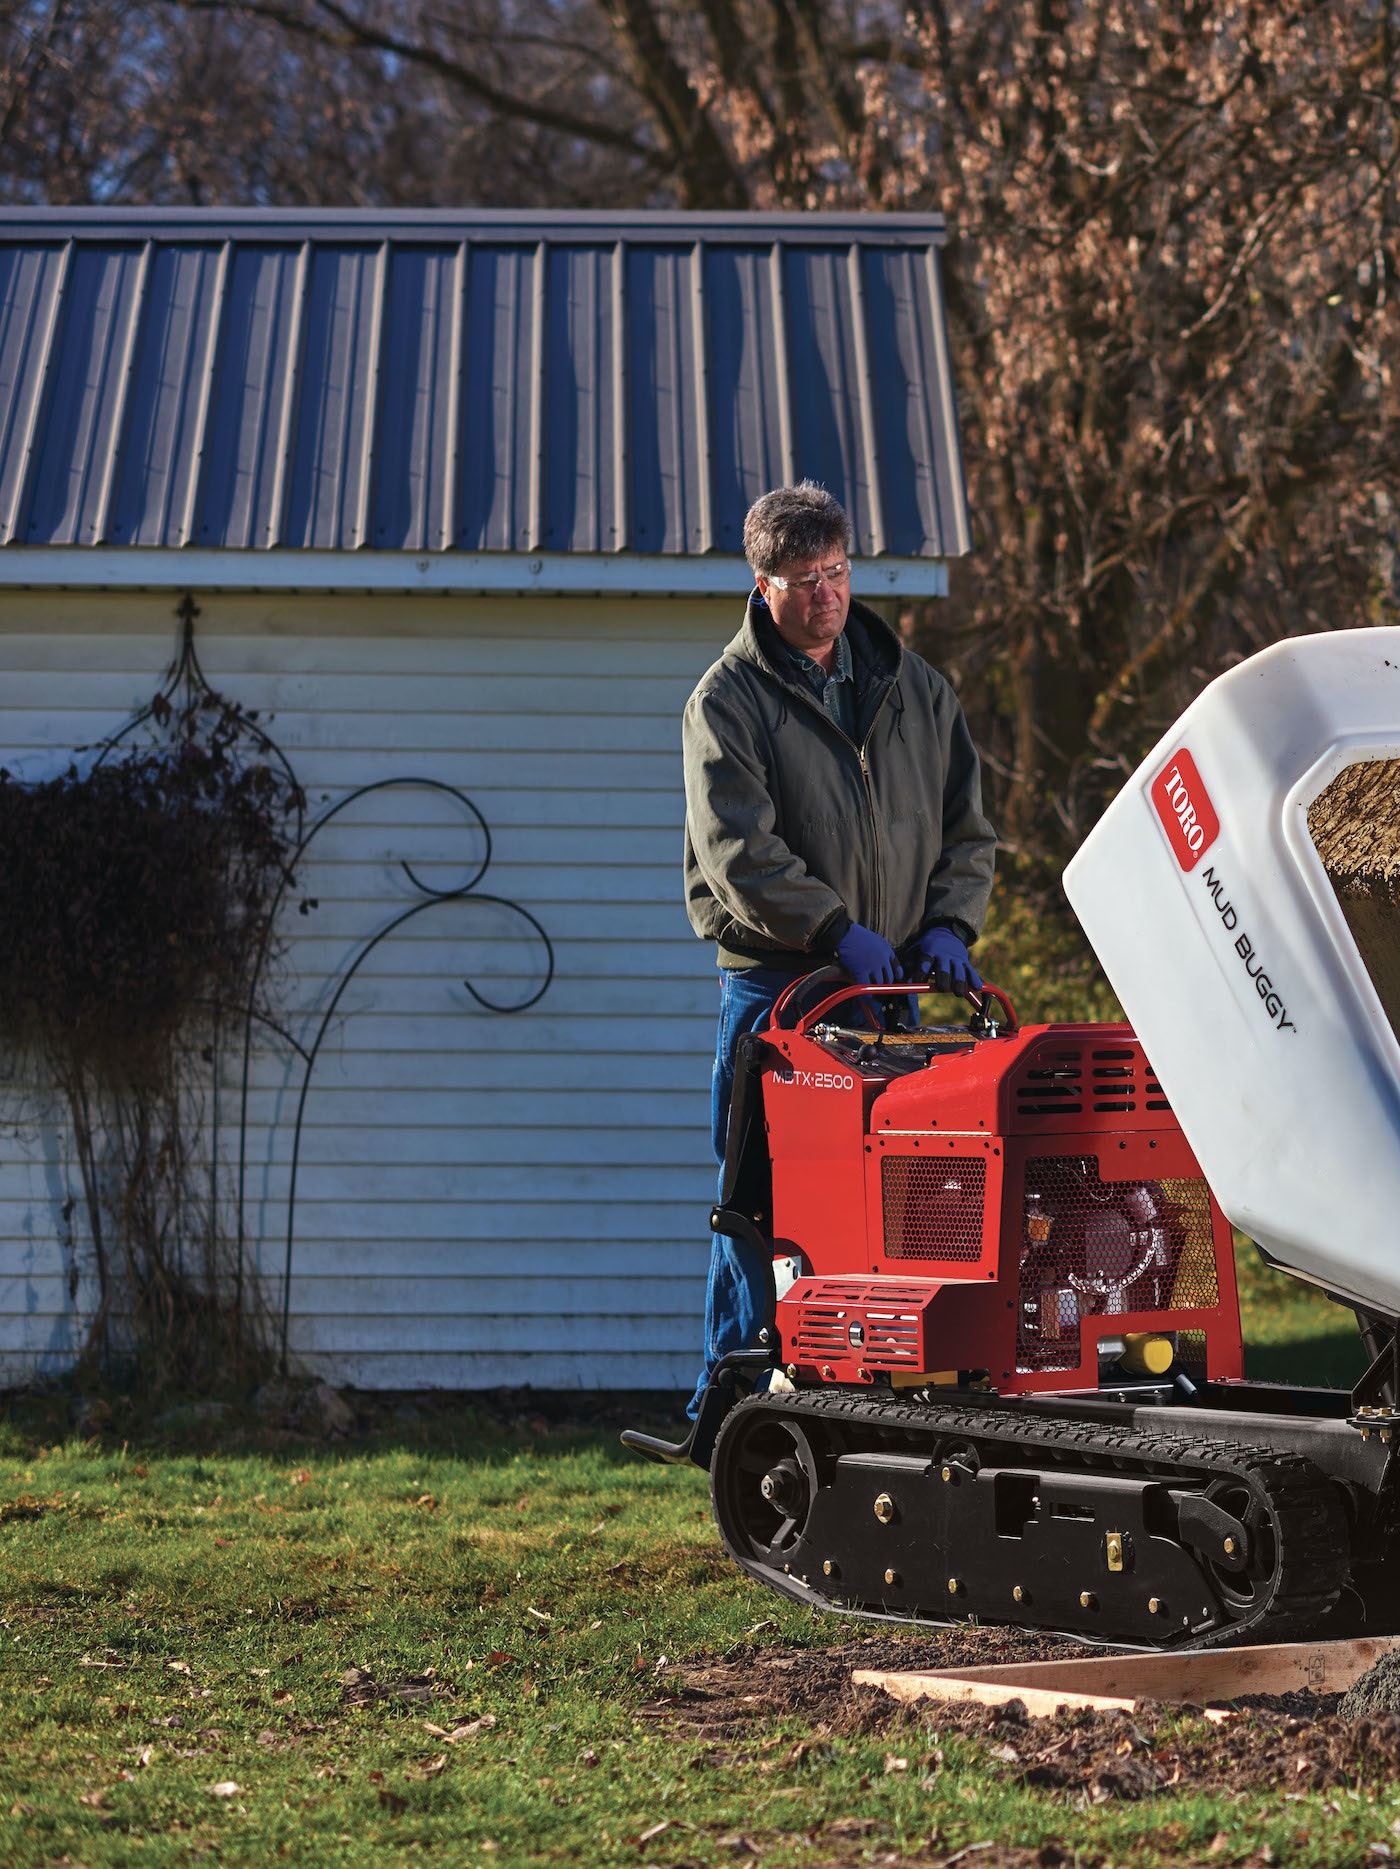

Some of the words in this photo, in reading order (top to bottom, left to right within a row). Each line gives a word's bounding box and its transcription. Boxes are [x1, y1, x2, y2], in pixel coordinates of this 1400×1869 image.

[1164, 765, 1205, 851] TORO
[1202, 866, 1238, 931] MUD
[1234, 932, 1295, 1031] BUGGY
